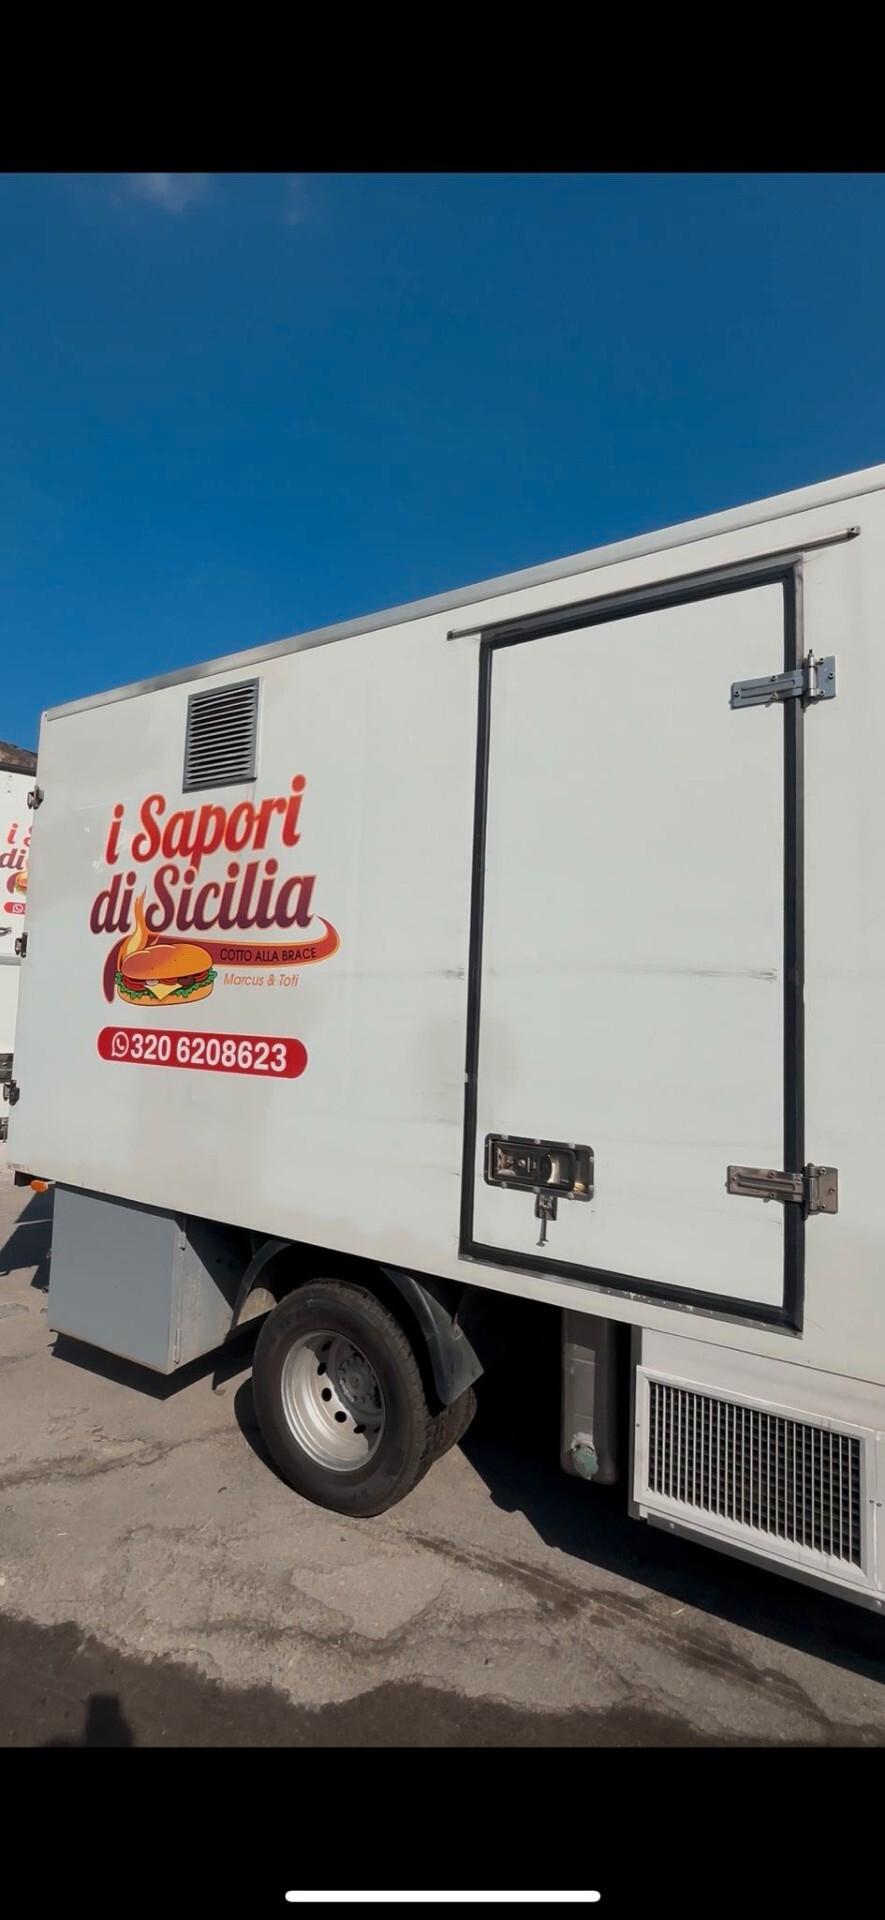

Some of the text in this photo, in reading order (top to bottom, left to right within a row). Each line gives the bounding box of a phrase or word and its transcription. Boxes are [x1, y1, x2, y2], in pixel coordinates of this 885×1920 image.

[105, 774, 307, 873] i Sapori
[0, 848, 26, 870] di
[90, 857, 317, 934] di Sicilia
[220, 947, 317, 961] COTTO ALLA BRACE
[223, 973, 264, 986] Marcus
[267, 973, 275, 986] &
[130, 1033, 288, 1073] 320 6208623
